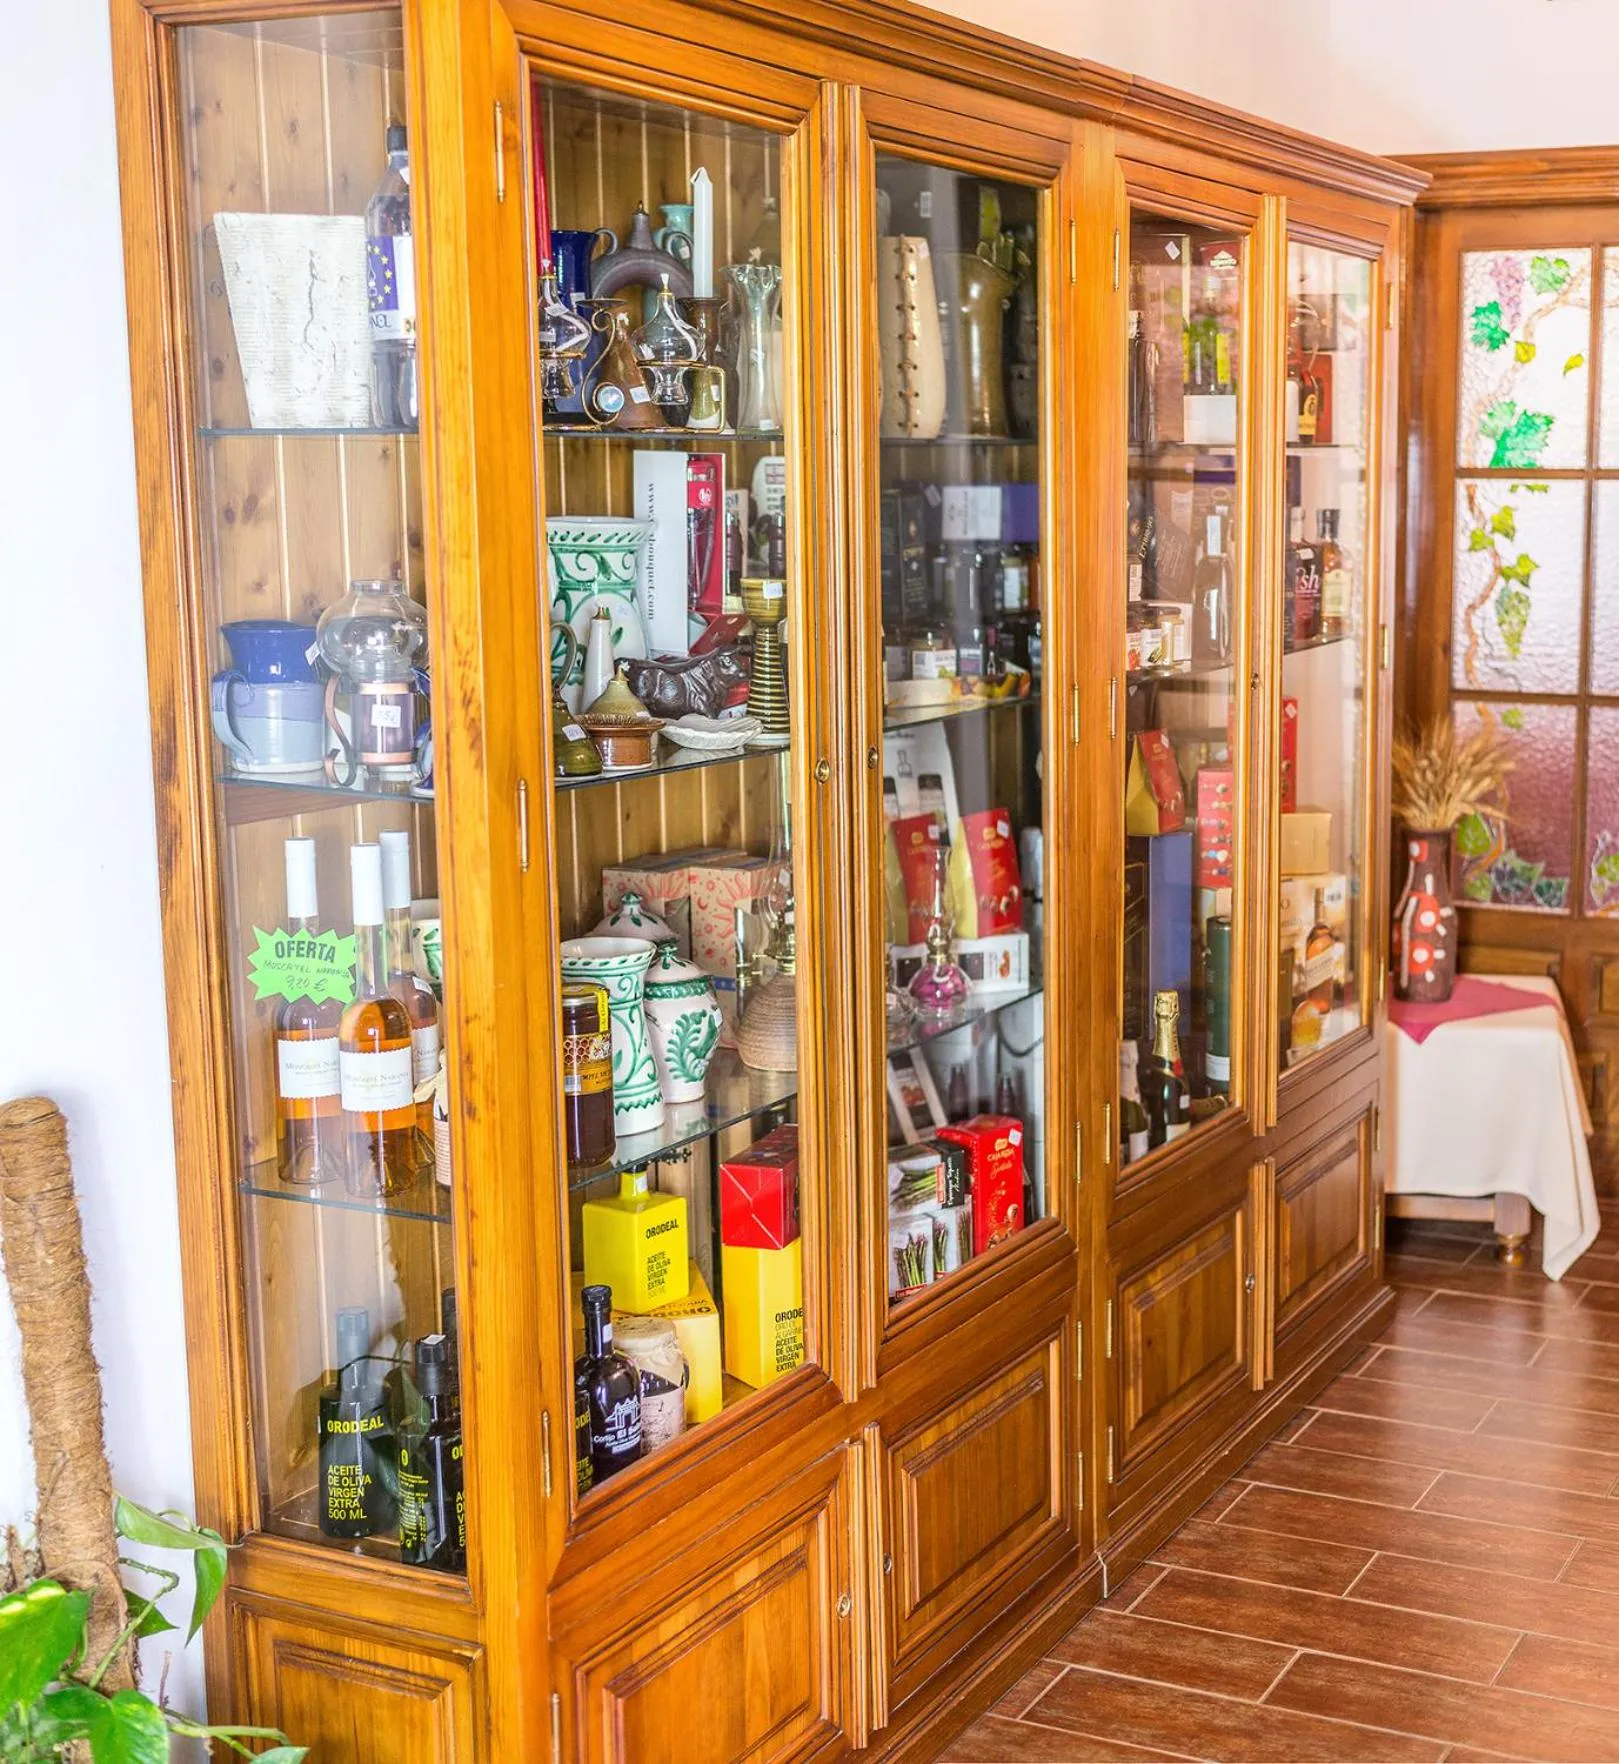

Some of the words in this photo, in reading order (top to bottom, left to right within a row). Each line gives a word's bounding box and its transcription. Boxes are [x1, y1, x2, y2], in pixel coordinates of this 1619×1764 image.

[274, 940, 336, 963] OFERTA
[263, 959, 312, 974] MOSCATEL
[645, 1218, 680, 1239] ORODEAL
[648, 1278, 665, 1291] EXTRA
[776, 1360, 797, 1373] EXTRA
[327, 1415, 385, 1434] ORODEAL
[327, 1464, 362, 1476] ACEITE
[328, 1475, 340, 1487] DE
[341, 1474, 372, 1487] OLIVA
[328, 1486, 365, 1498] VIRGEN
[328, 1497, 361, 1509] EXTRA
[328, 1508, 347, 1520] 500
[349, 1508, 368, 1520] ML
